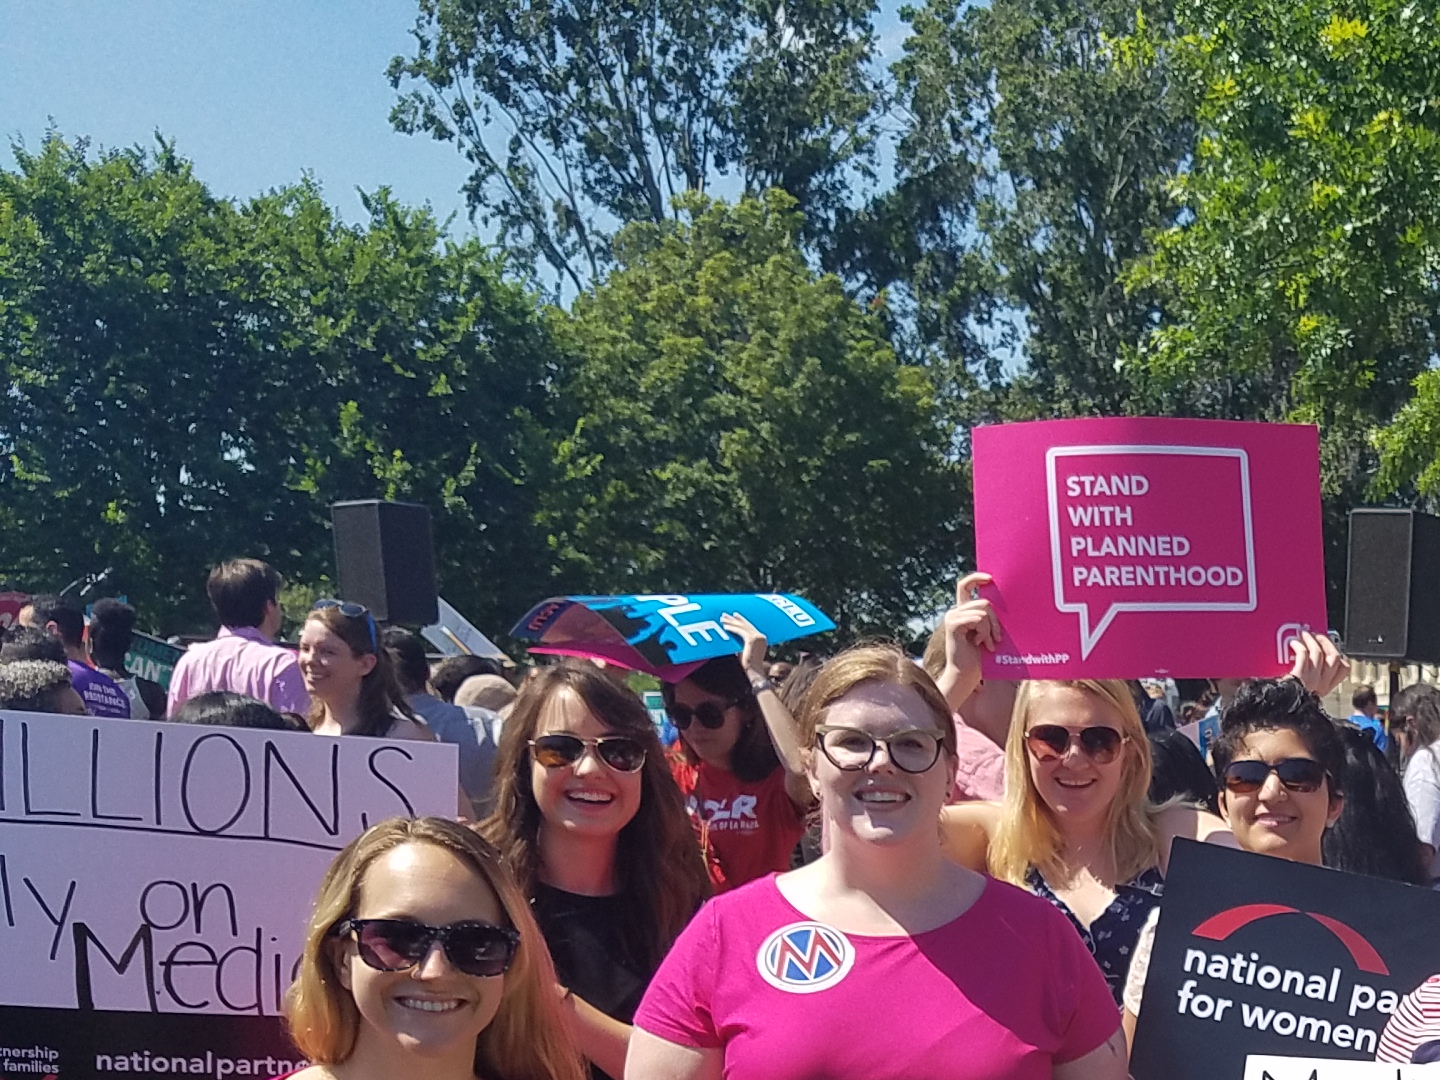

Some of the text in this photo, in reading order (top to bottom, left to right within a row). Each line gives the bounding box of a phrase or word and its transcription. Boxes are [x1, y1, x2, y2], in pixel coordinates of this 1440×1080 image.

[1066, 475, 1149, 496] STAND
[1067, 505, 1133, 526] WITH
[1070, 535, 1190, 557] PLANNED
[1073, 565, 1244, 586] PARENTHOOD
[995, 653, 1070, 665] #StandwithPP
[140, 881, 238, 936] on
[73, 922, 303, 1017] Medi
[1183, 945, 1406, 1016] national pa
[1178, 980, 1377, 1053] for women
[3, 1058, 60, 1074] families
